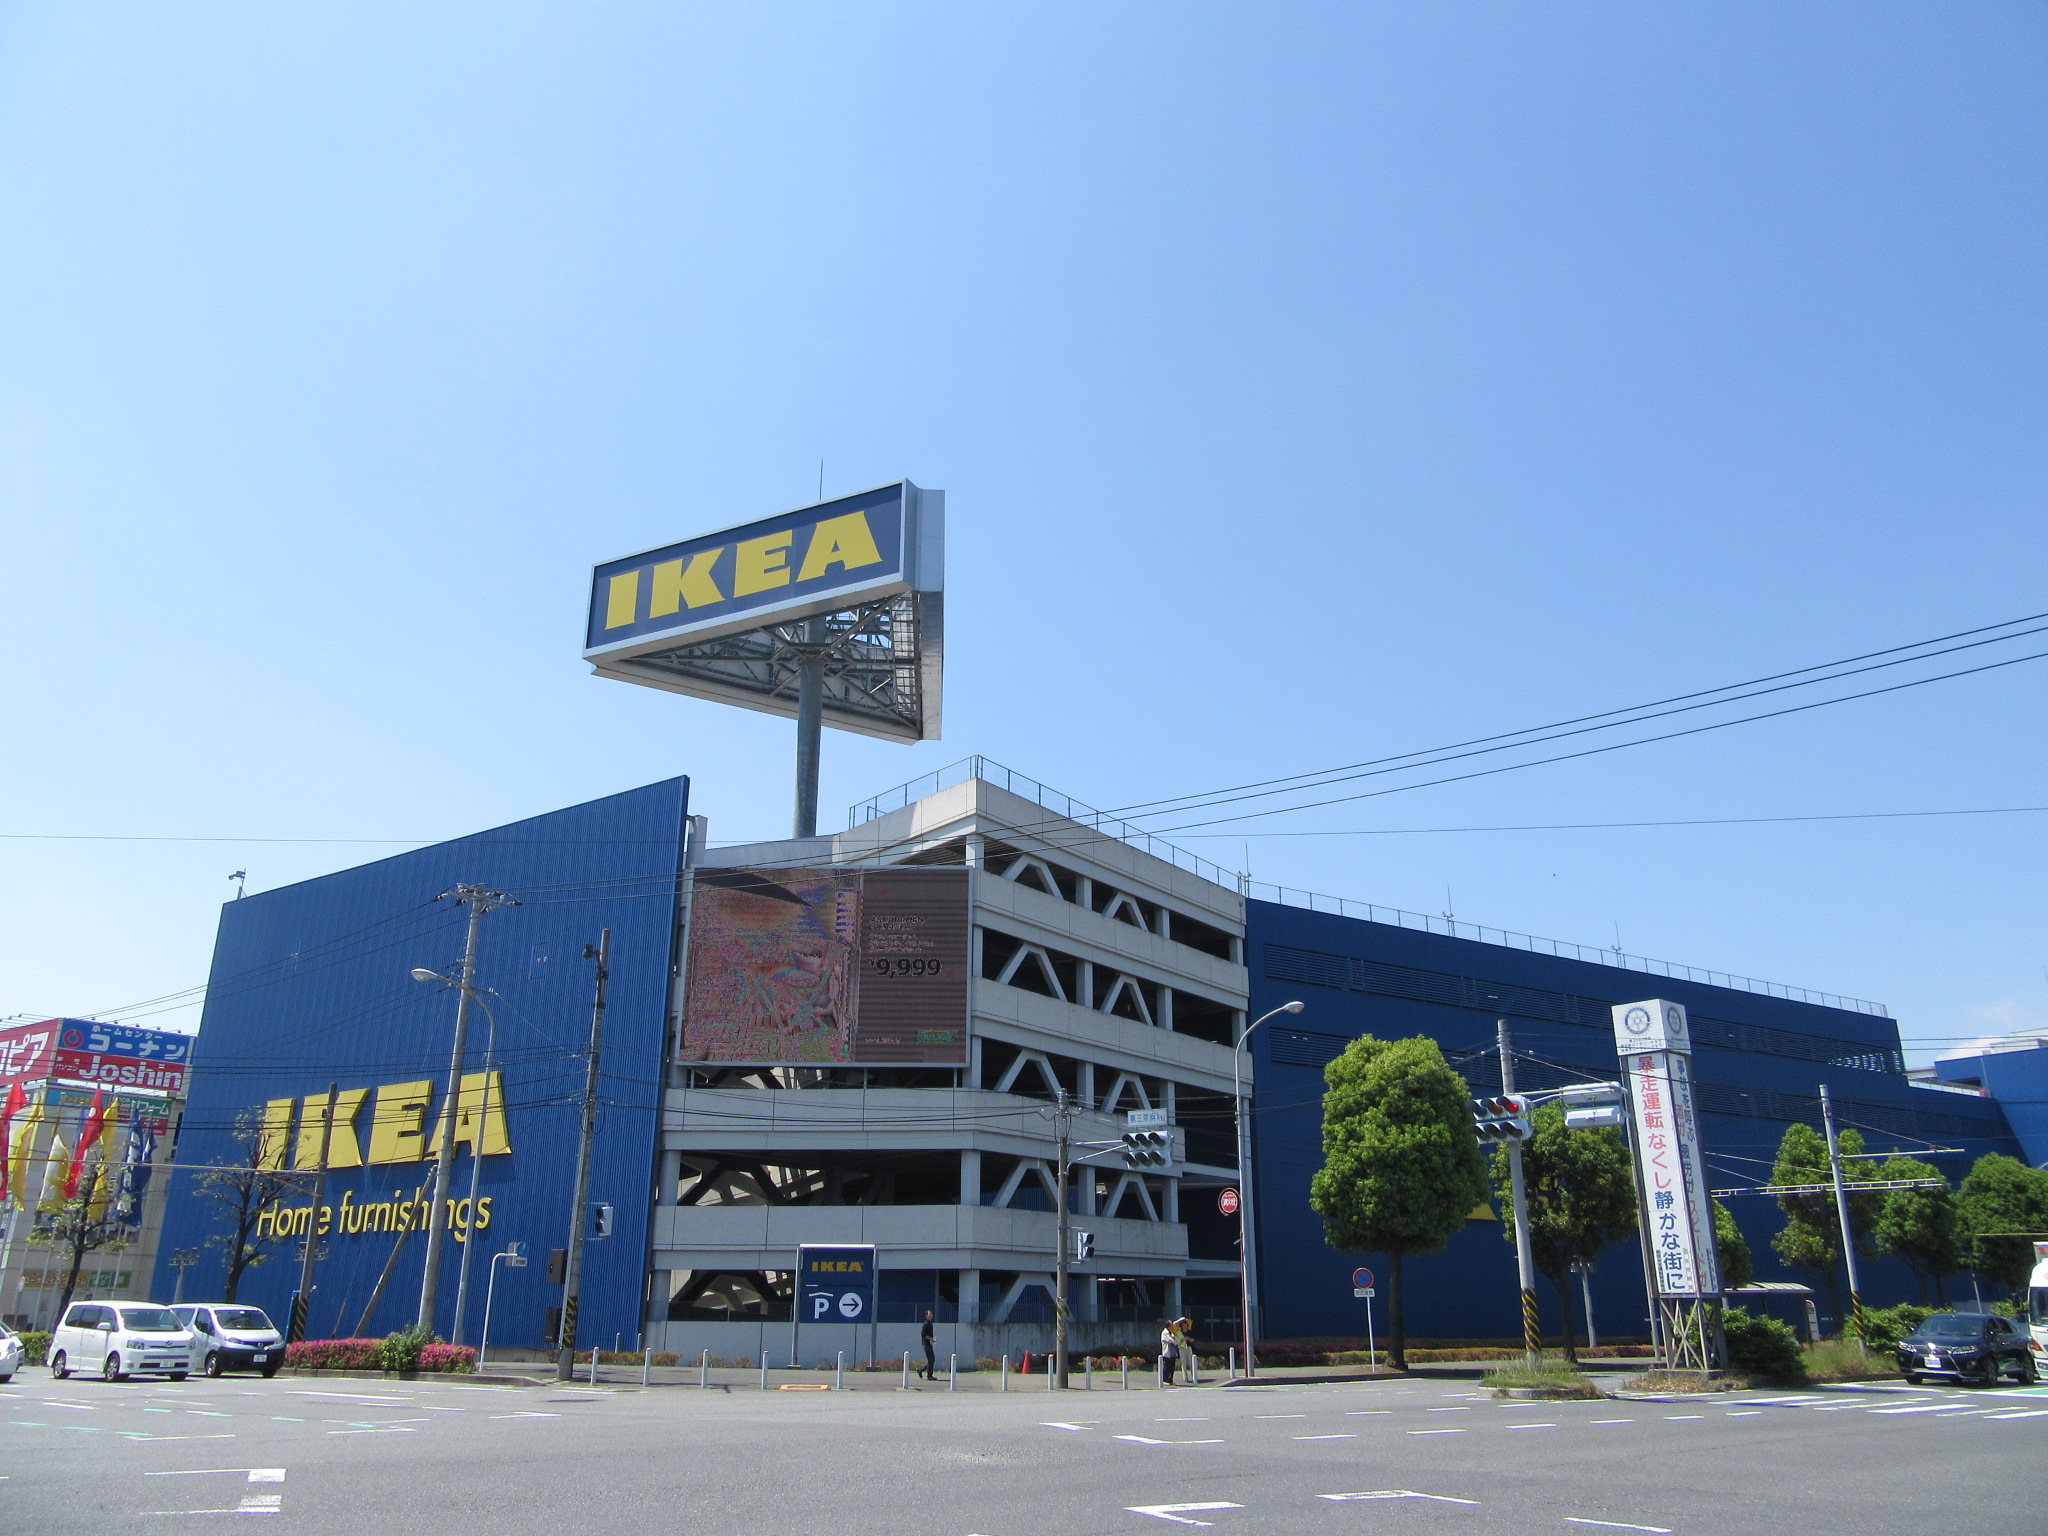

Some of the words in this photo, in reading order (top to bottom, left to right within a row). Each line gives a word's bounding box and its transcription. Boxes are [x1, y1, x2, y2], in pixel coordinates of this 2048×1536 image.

[605, 510, 883, 630] IKEA
[88, 1033, 186, 1060] コーナン
[92, 1025, 163, 1040] ホームセンター
[79, 1055, 183, 1089] Joshin
[257, 1070, 513, 1173] IKEA
[1638, 1056, 1686, 1291] 暴走運転なくし静かな街に
[256, 1199, 332, 1237] Home
[339, 1187, 493, 1242] furnishngs
[811, 1261, 863, 1273] IKEA
[814, 1297, 830, 1319] P
